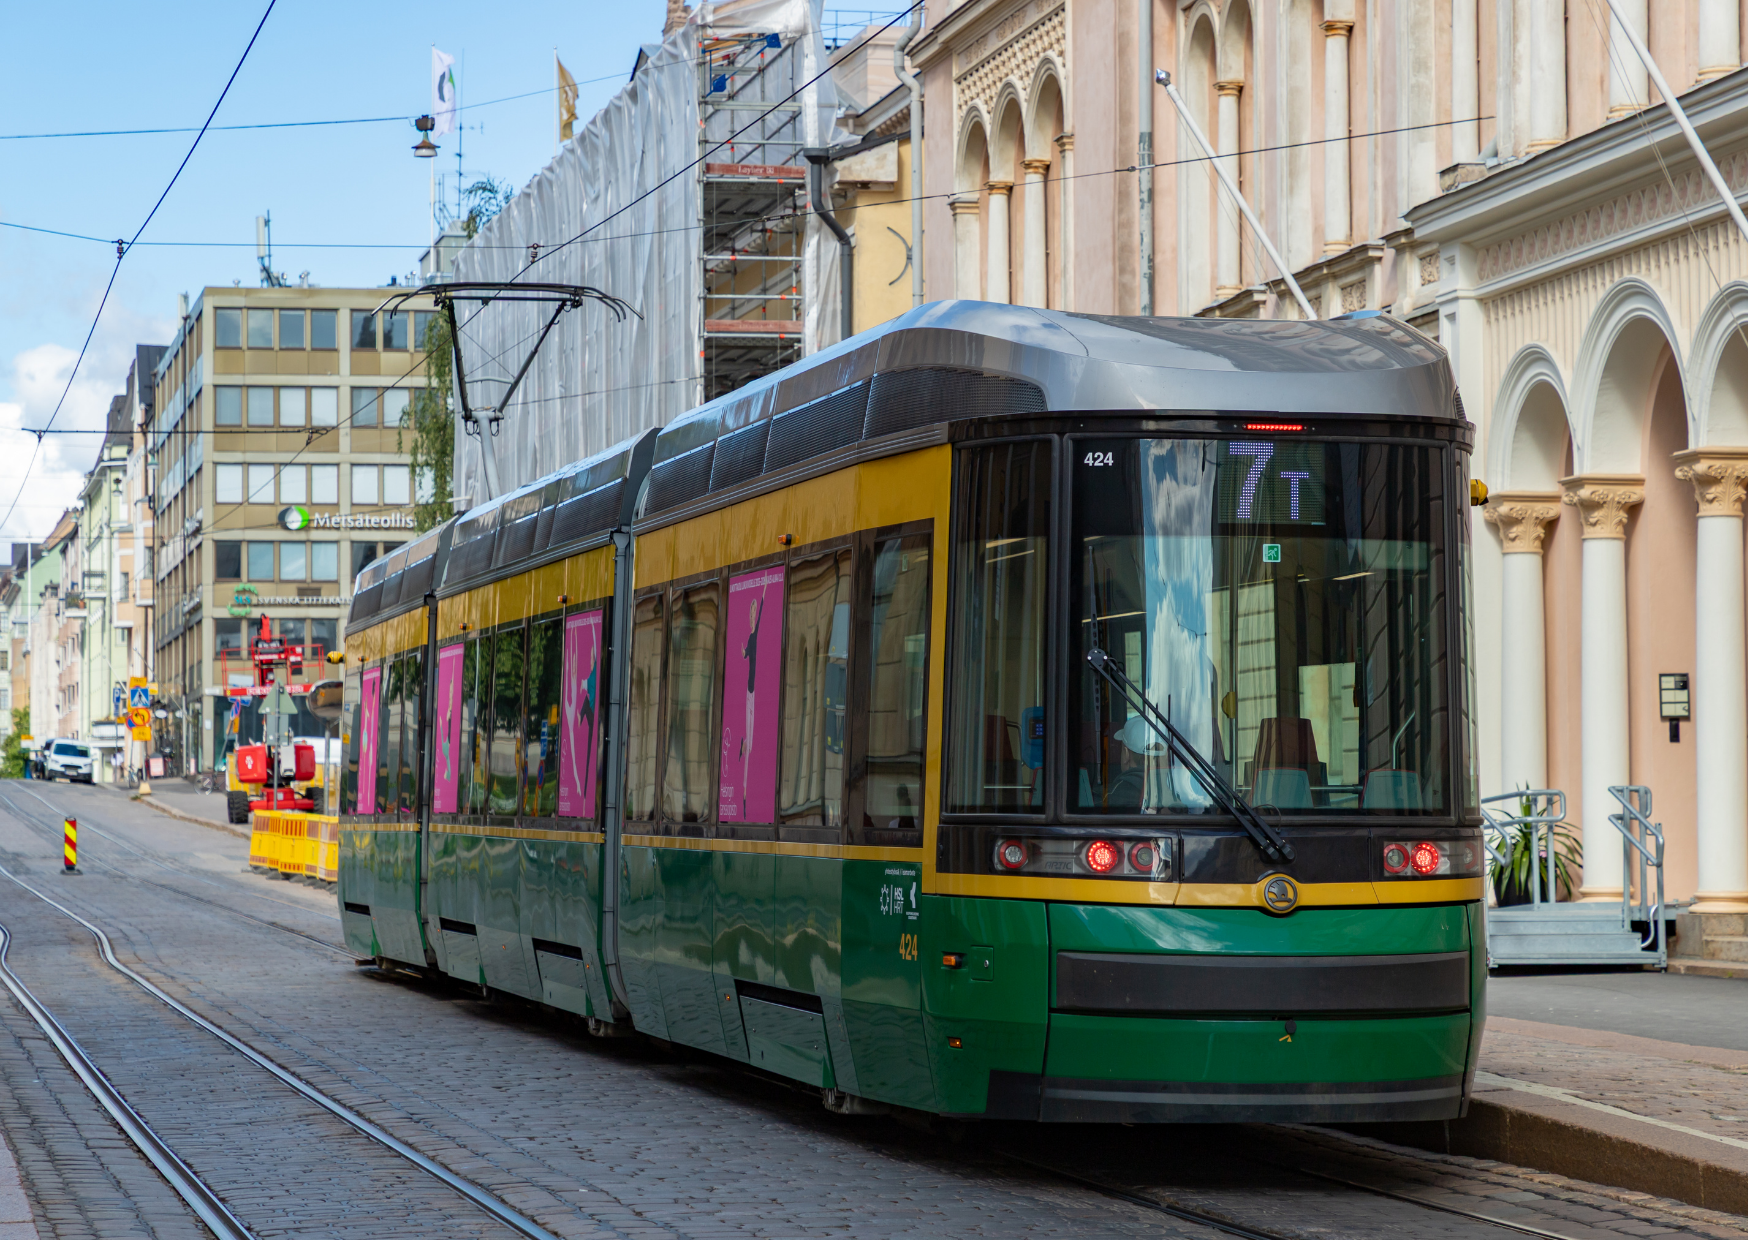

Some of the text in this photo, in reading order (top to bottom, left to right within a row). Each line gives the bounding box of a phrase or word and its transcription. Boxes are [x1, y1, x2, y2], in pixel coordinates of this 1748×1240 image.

[739, 165, 764, 175] Layher
[1084, 452, 1114, 467] 424
[314, 512, 417, 528] Metsäteollis
[258, 596, 300, 605] SVENSKA
[1045, 861, 1072, 870] ARTIC
[894, 887, 904, 900] HSL
[893, 900, 904, 914] HRT
[899, 932, 918, 961] 424
